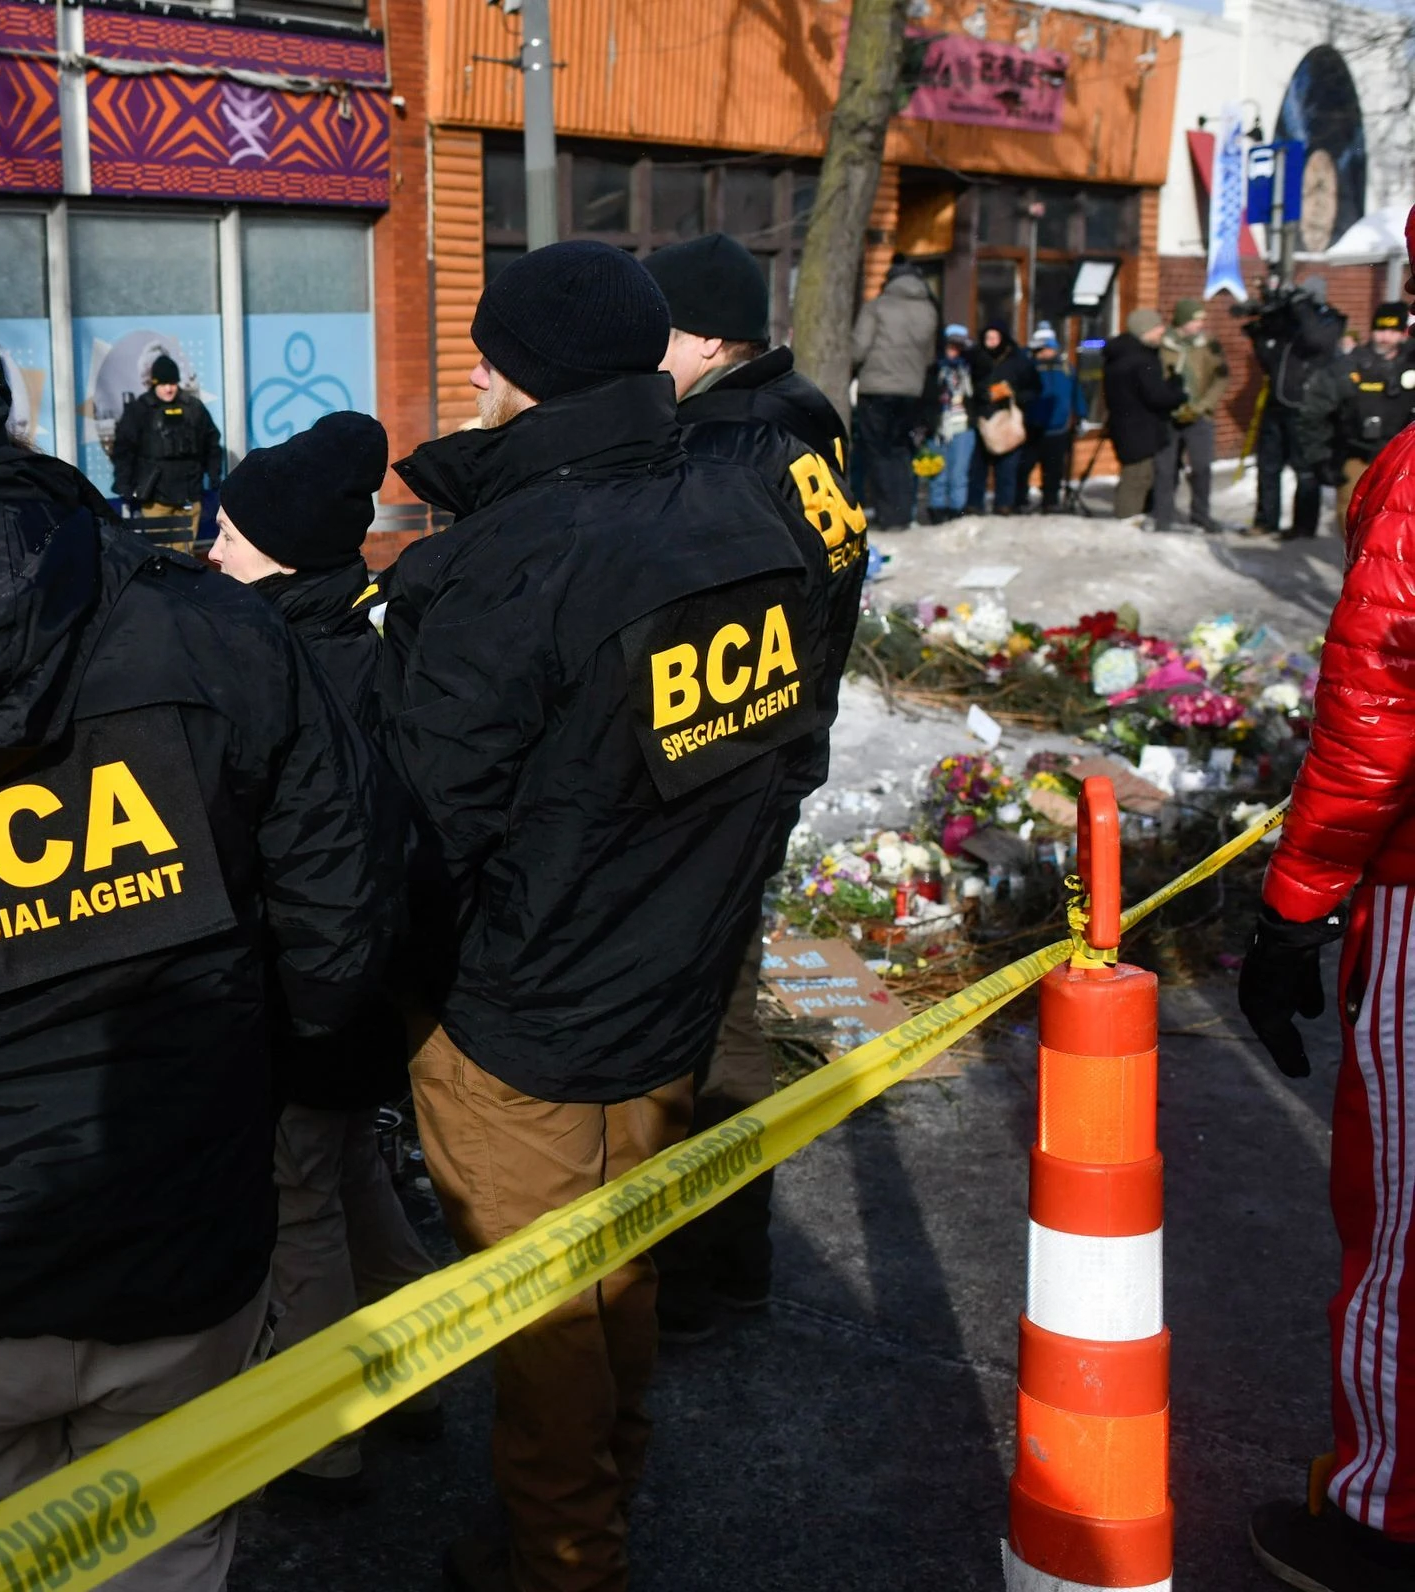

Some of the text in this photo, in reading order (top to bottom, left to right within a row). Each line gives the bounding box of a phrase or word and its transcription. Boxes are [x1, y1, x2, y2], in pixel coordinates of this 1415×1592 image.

[651, 604, 798, 730] BCA
[661, 681, 800, 761] SPECIAL AGENT
[69, 862, 184, 922] AGENT
